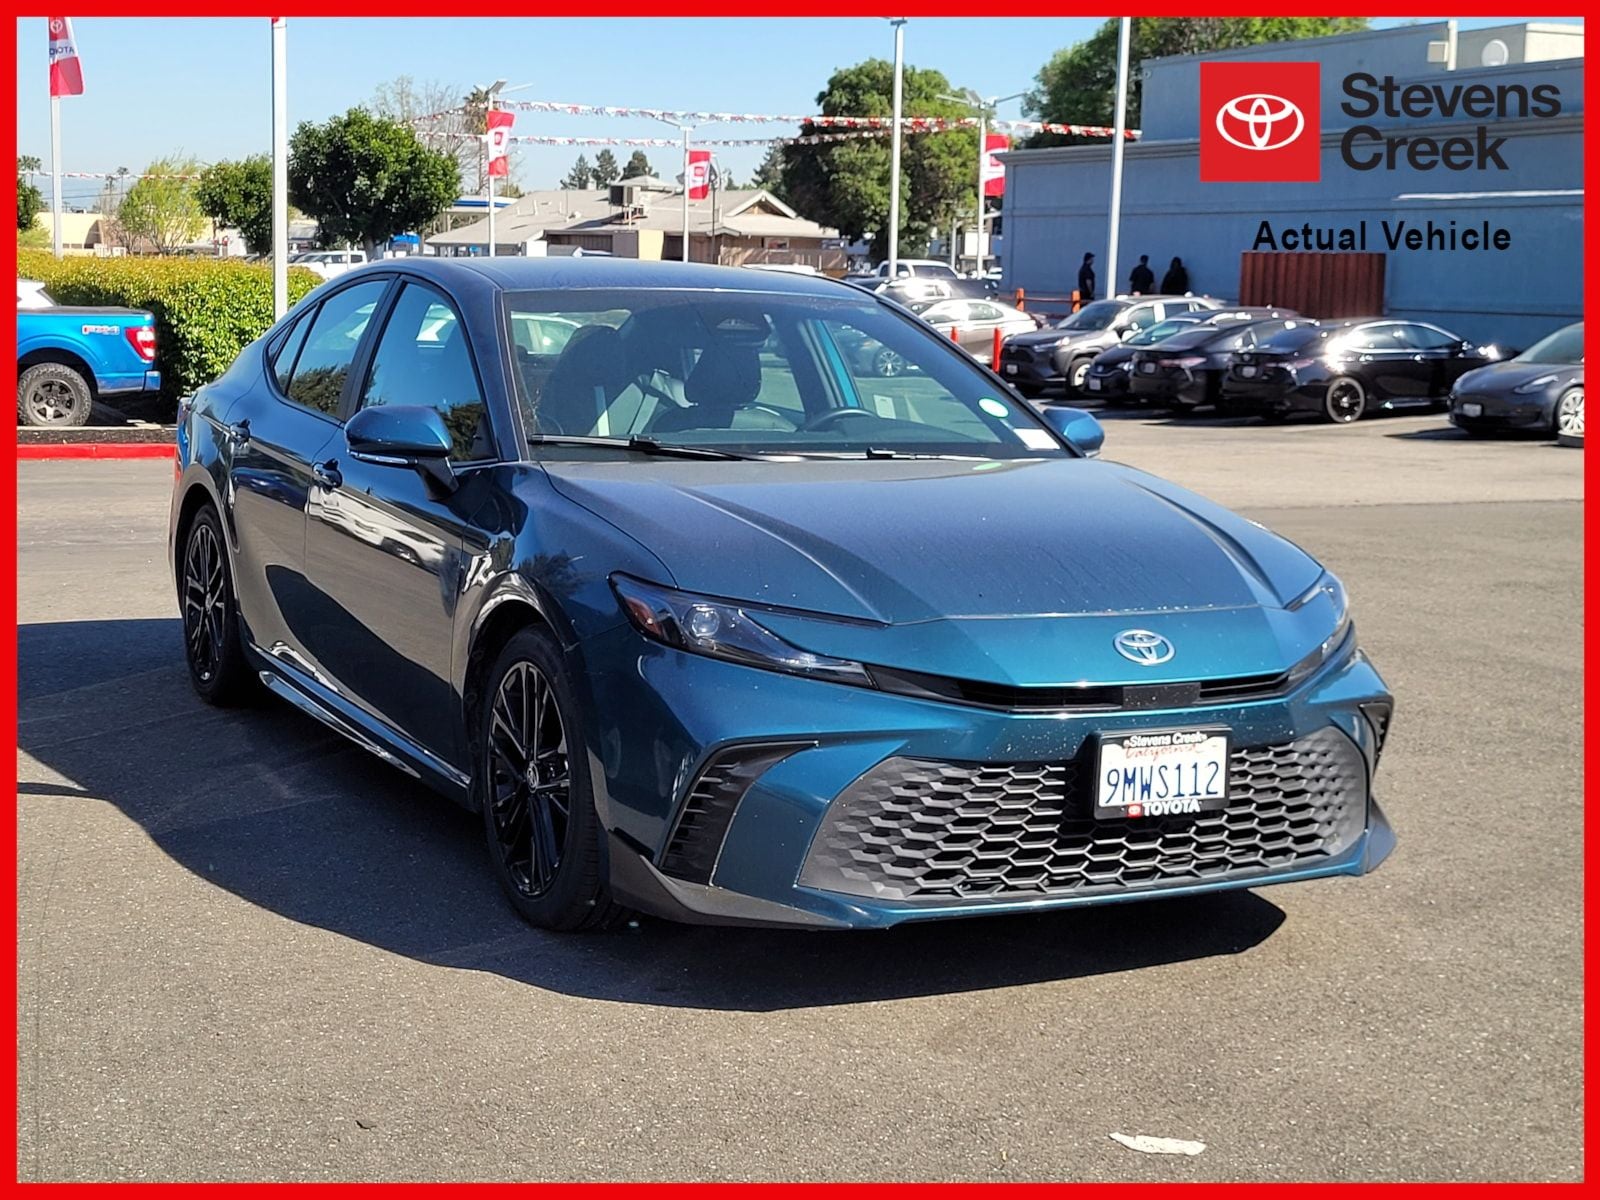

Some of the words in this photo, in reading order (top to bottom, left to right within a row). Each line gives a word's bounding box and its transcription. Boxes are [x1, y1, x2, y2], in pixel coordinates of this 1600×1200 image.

[1129, 734, 1171, 748] Stevens
[1172, 732, 1203, 745] Creek
[1105, 761, 1219, 804] 9MWS112
[1142, 800, 1200, 817] TOYOTA
